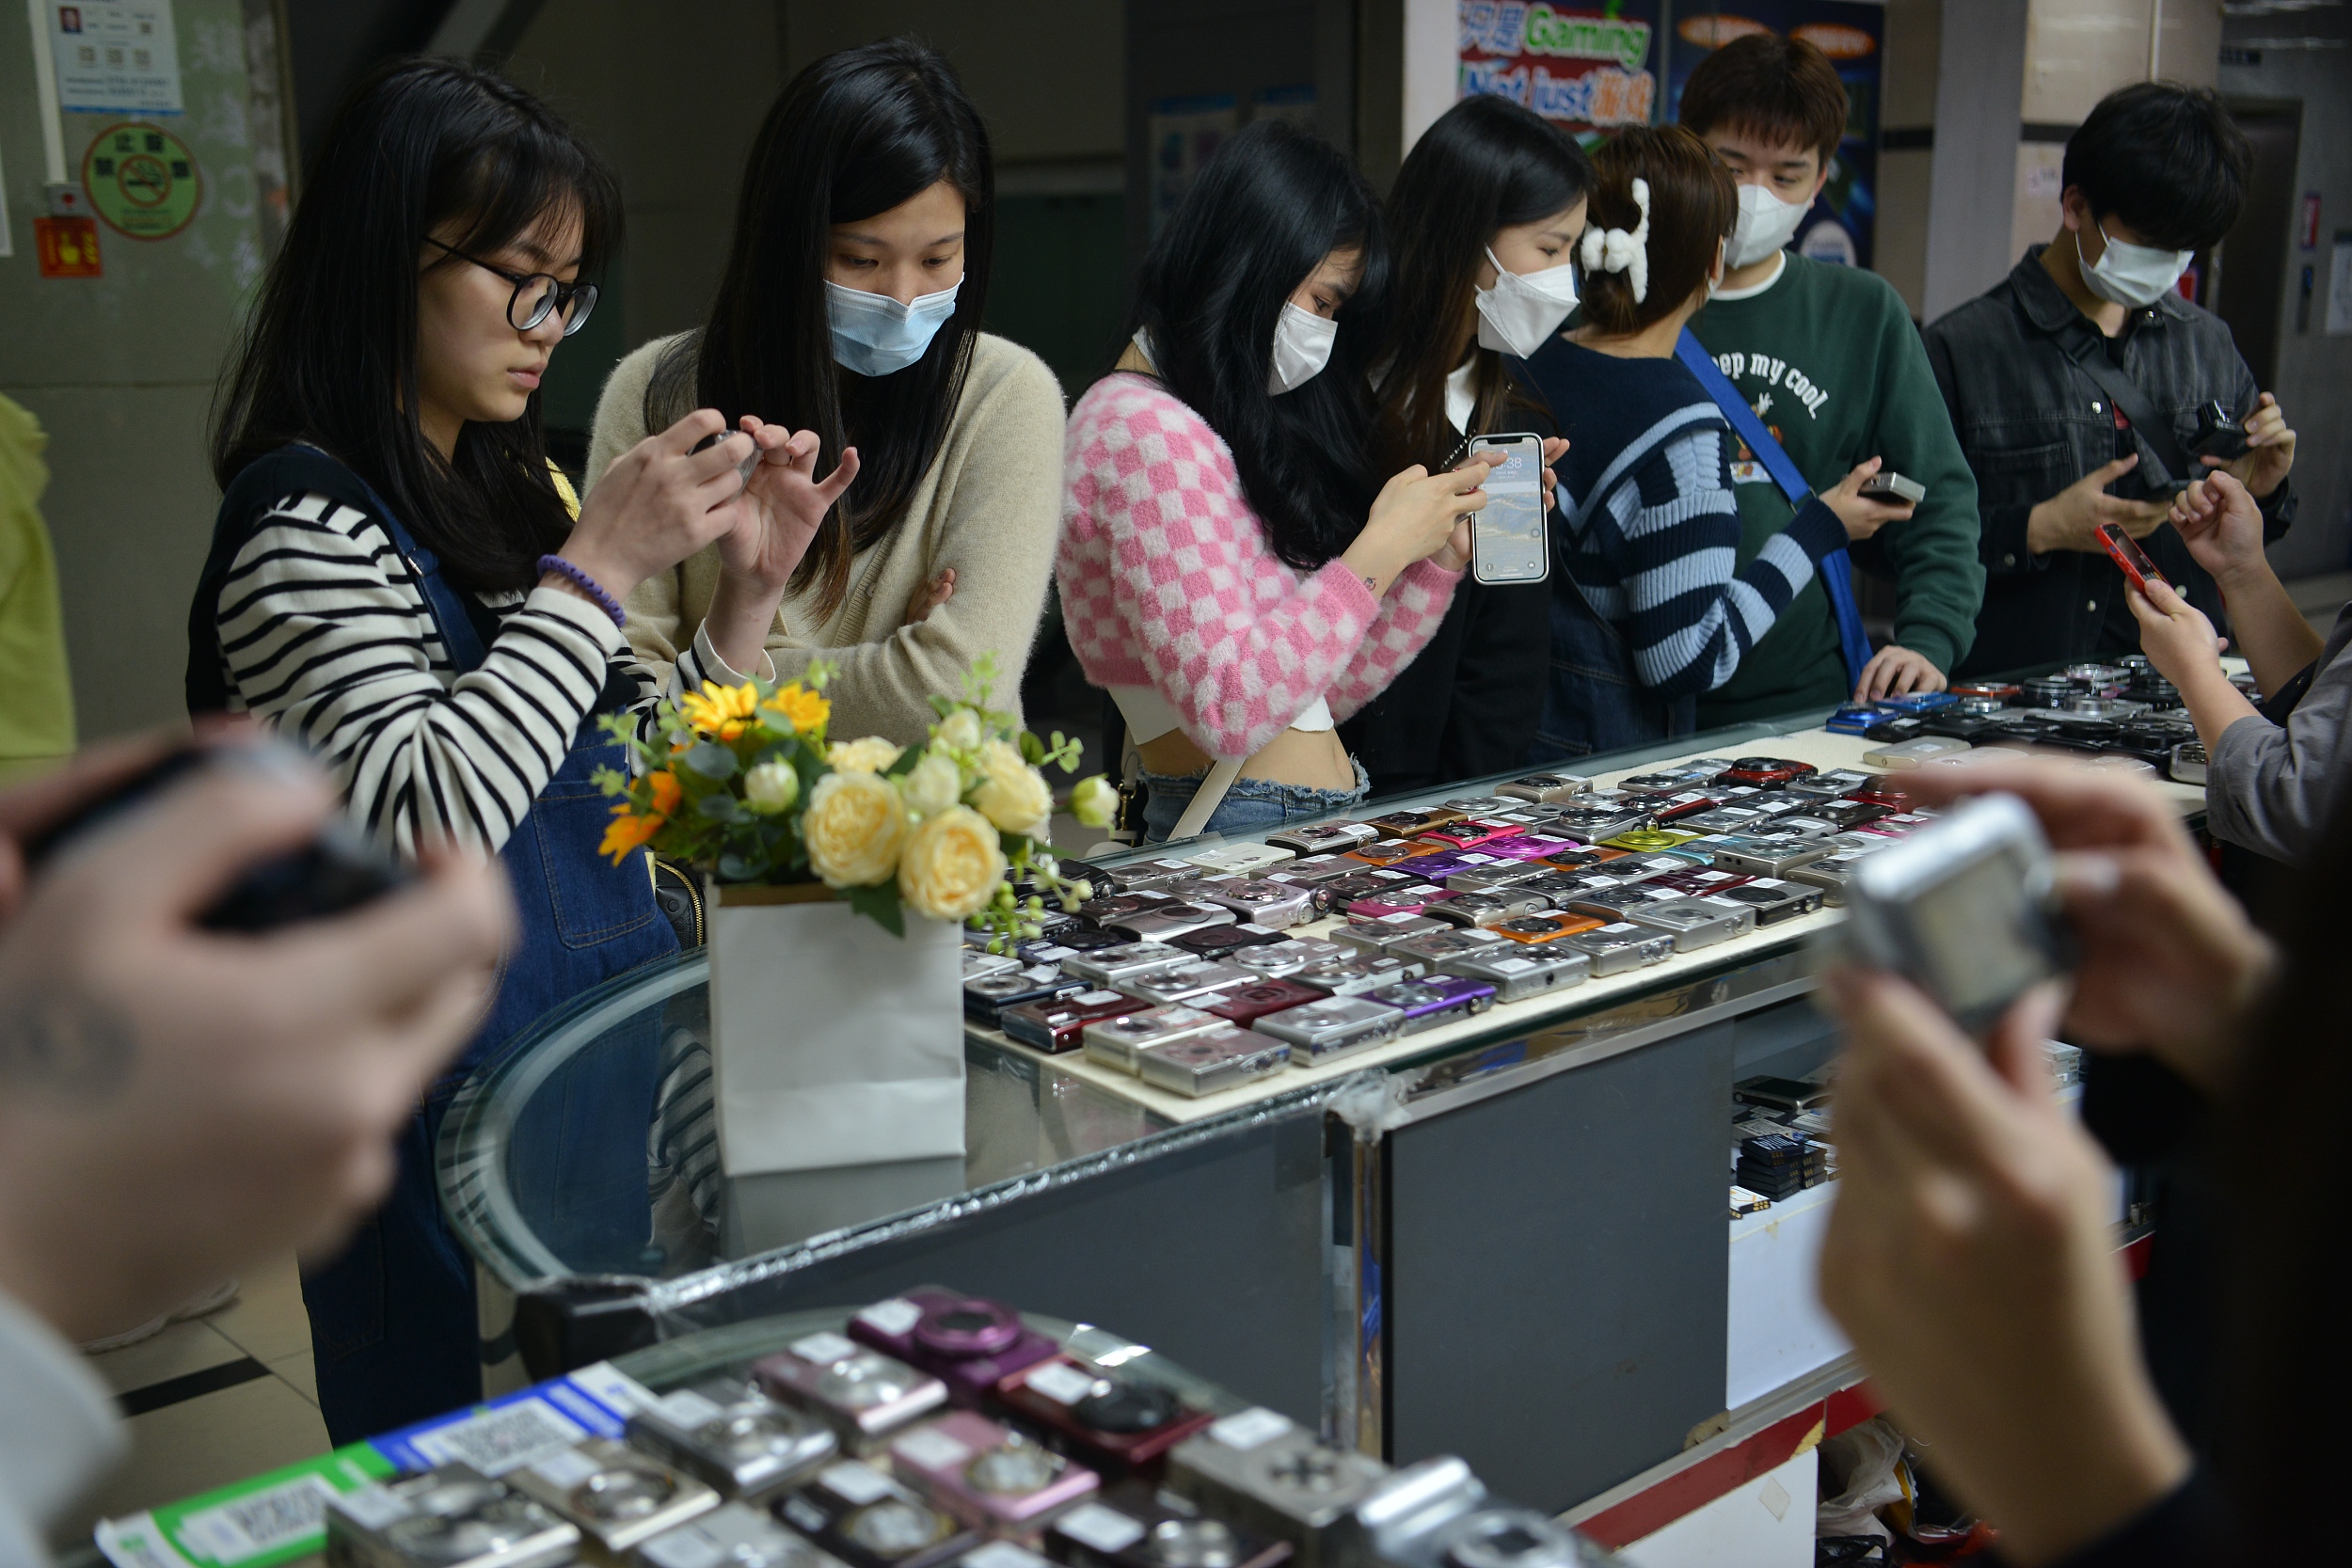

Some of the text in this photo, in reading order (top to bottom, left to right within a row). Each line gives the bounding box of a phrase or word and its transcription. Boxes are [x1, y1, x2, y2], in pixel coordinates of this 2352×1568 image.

[1524, 4, 1650, 70] Gaming
[1531, 67, 1593, 117] just
[1711, 352, 1829, 420] ep my cool
